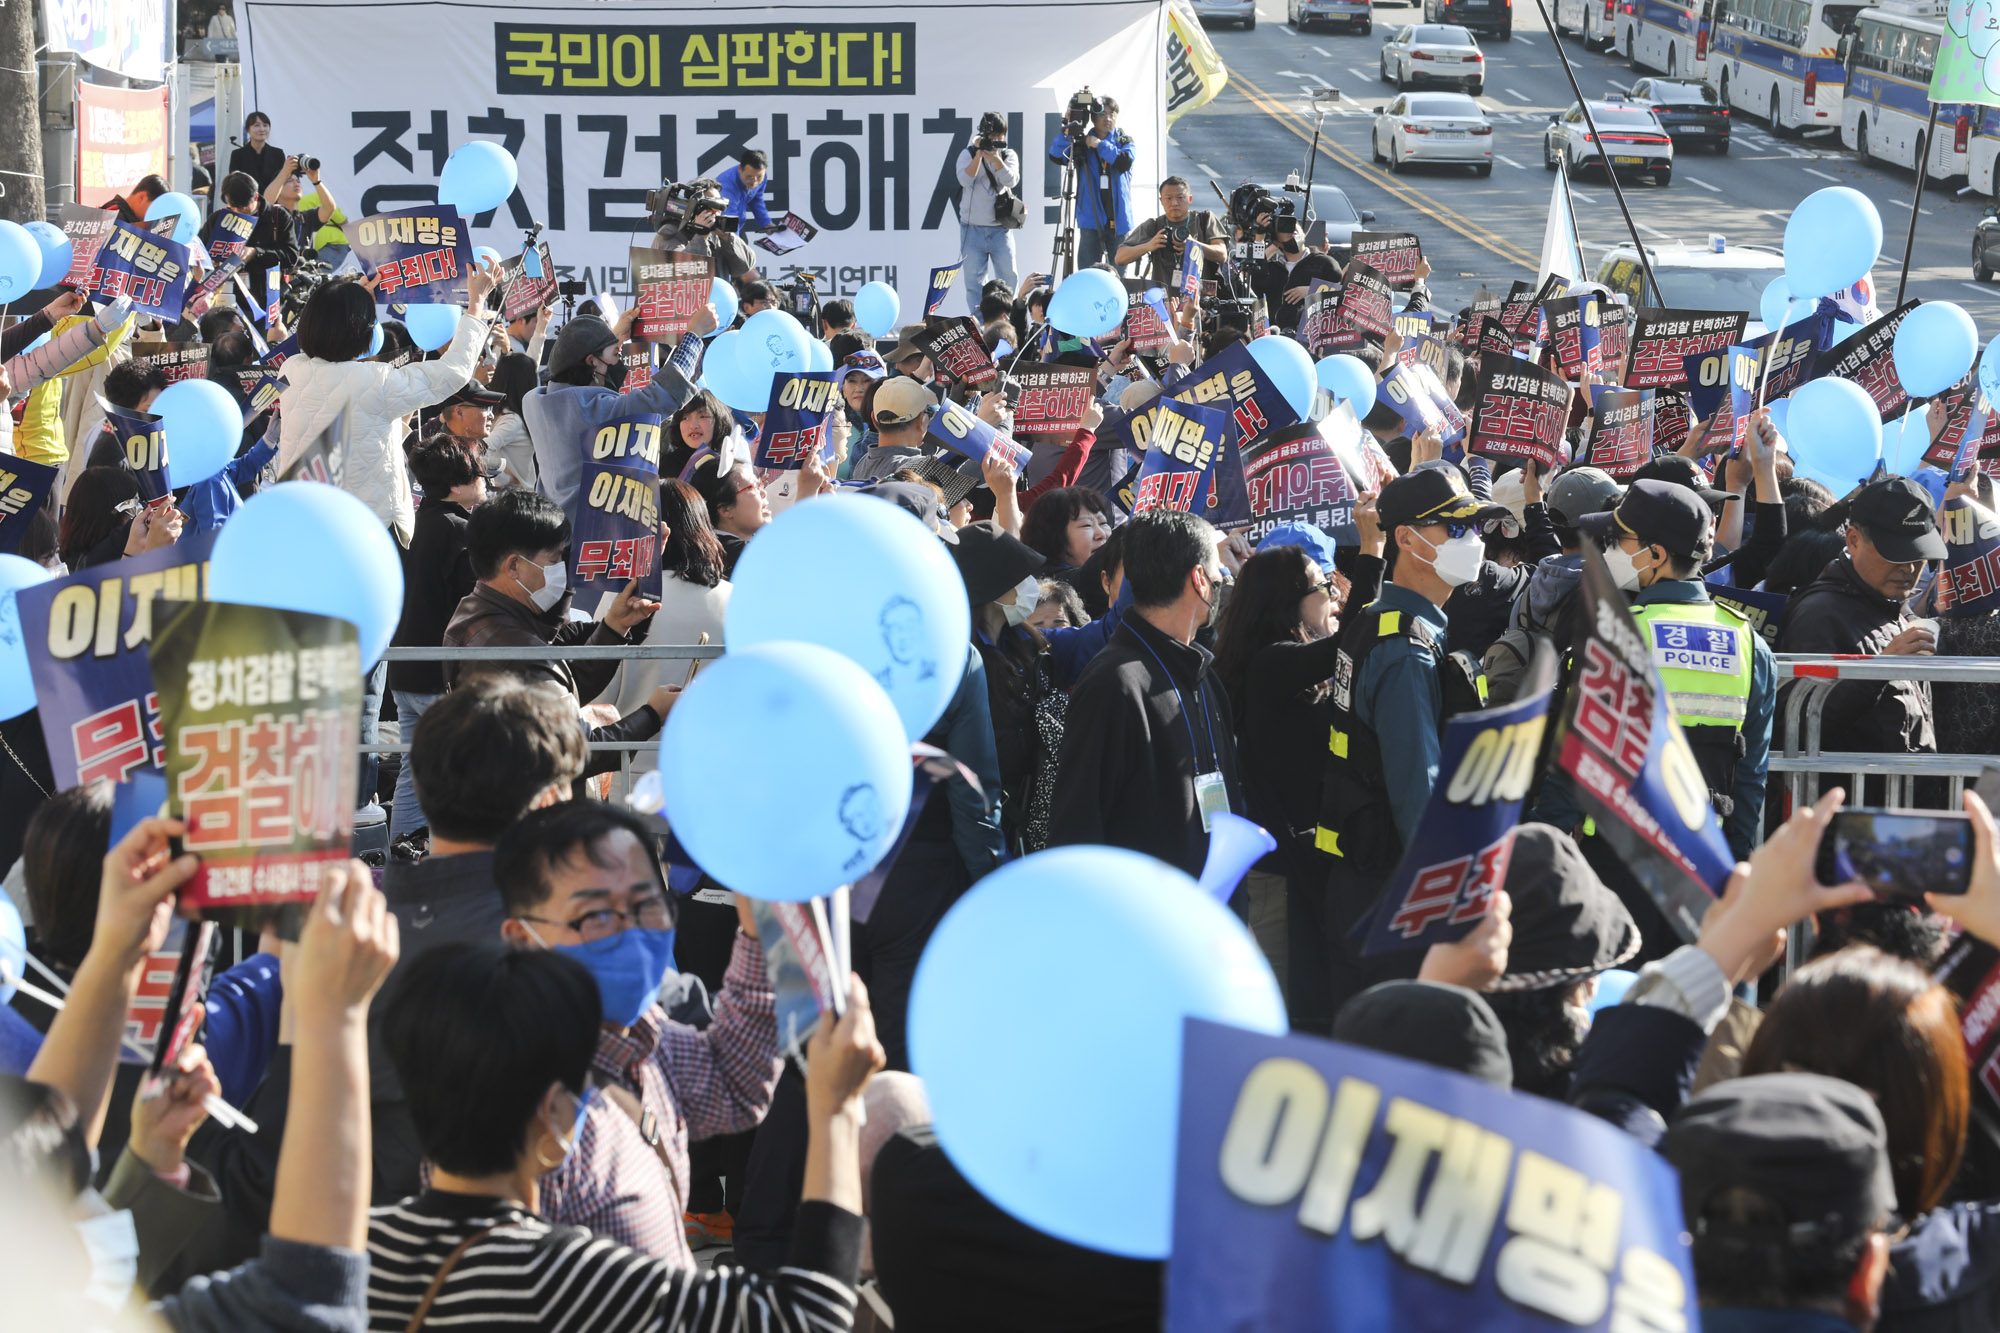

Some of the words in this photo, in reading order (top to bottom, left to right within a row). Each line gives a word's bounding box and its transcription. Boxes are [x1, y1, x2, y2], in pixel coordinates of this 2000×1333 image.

[506, 31, 660, 91] 국민이
[679, 28, 903, 90] 심판한다!
[63, 220, 98, 236] 정치검찰
[358, 216, 457, 248] 이재명은
[1358, 240, 1387, 253] 정치검찰
[376, 248, 459, 295] 무죄다!
[640, 262, 674, 280] 정치검찰
[1354, 271, 1382, 291] 정치검찰
[638, 278, 711, 320] 검찰해체
[642, 324, 659, 333] 김건희
[928, 324, 959, 353] 정치검찰
[1644, 320, 1690, 337] 정치검찰
[1692, 315, 1739, 332] 탄핵하라!
[181, 347, 209, 362] 탄핵하라!
[1632, 330, 1738, 373] 검찰해체
[1010, 371, 1049, 387] 정치검찰
[1049, 371, 1090, 386] 탄핵하라!
[1491, 373, 1540, 398] 정치검찰
[1639, 375, 1659, 384] 김건희
[1660, 373, 1685, 383] 수사검사
[1478, 393, 1566, 449] 검찰해체
[1603, 402, 1640, 426] 정치검찰
[1026, 422, 1049, 432] 수사검사
[1049, 422, 1060, 432] 전원
[1152, 405, 1215, 472] 이재명은
[1280, 443, 1300, 457] 전원
[1485, 440, 1508, 452] 김건희
[1509, 443, 1536, 456] 수사검사
[588, 471, 659, 536] 이재명은
[1133, 471, 1200, 513] 무죄다!
[575, 535, 656, 582] 무죄다!
[1664, 651, 1730, 669] POLICE
[187, 649, 297, 713] 정치검찰
[207, 868, 253, 899] 김건희
[254, 861, 302, 895] 수사검사
[1218, 1055, 1690, 1333] 이재명은
